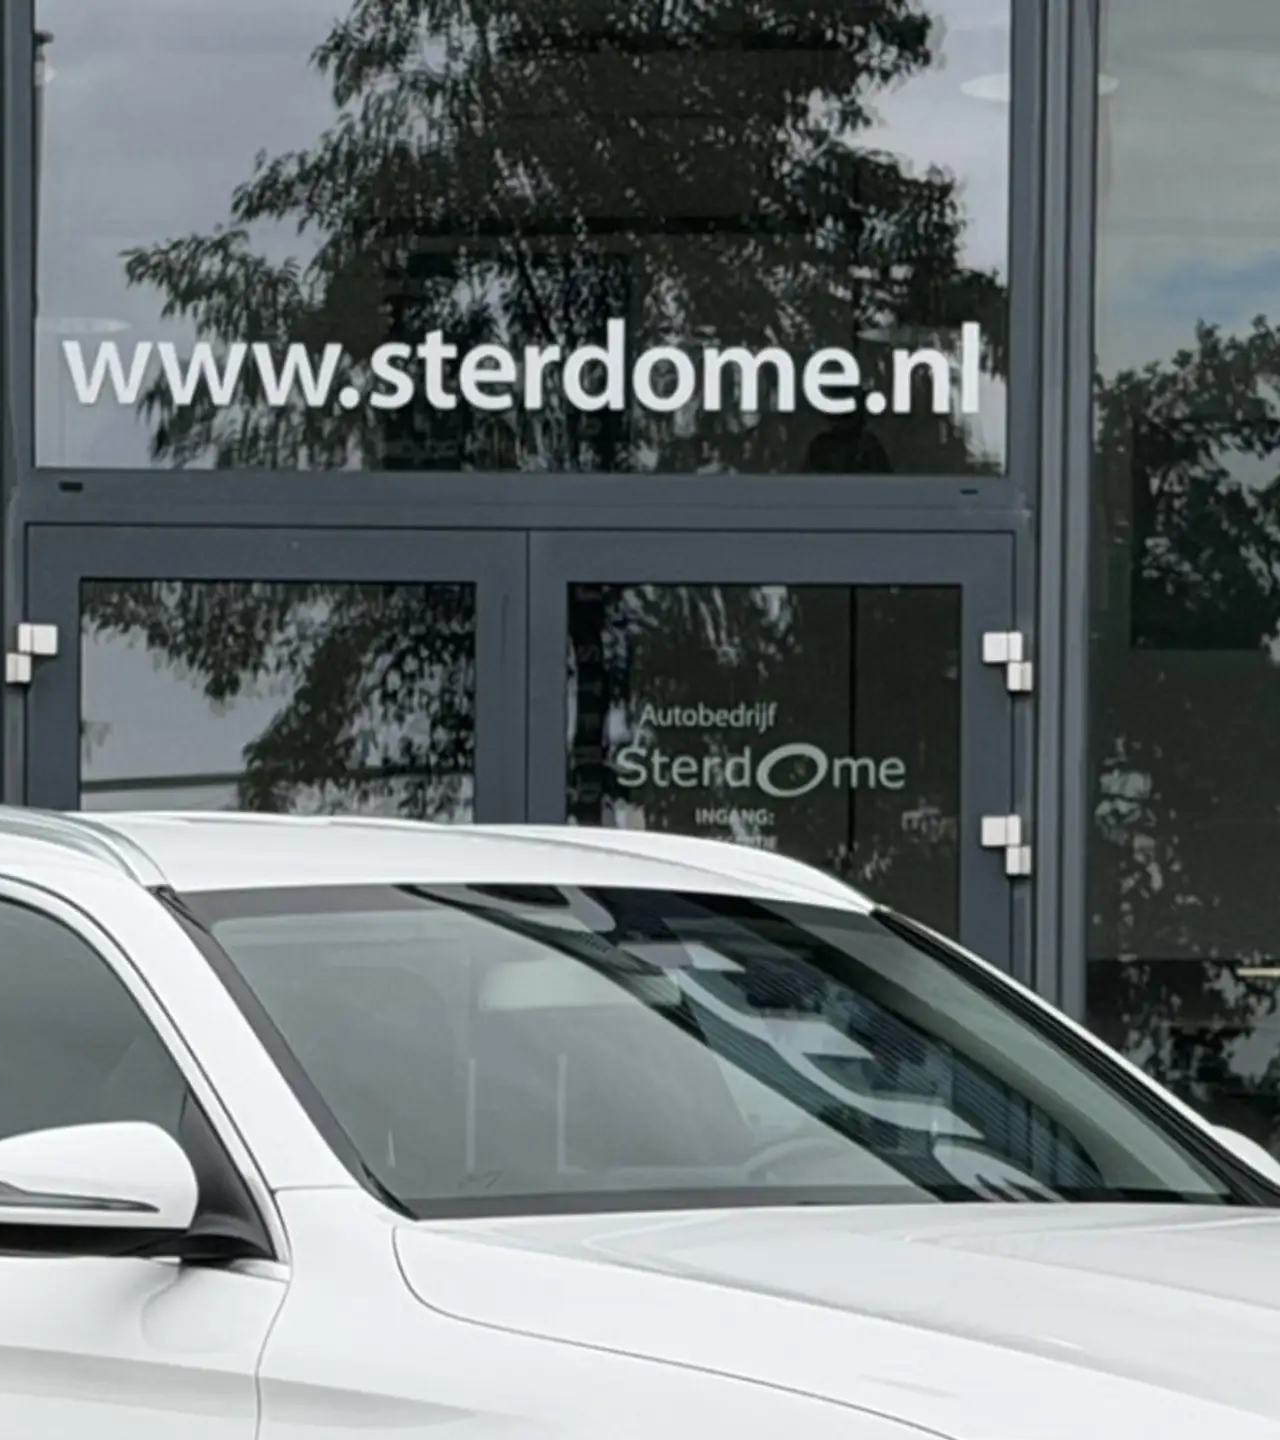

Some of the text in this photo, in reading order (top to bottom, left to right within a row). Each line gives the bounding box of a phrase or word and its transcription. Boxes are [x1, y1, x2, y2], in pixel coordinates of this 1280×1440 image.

[62, 318, 980, 416] www.sterdome.nl
[641, 701, 778, 733] Autobedrijf
[616, 742, 907, 797] SterdOme
[694, 807, 775, 826] INGANG:
